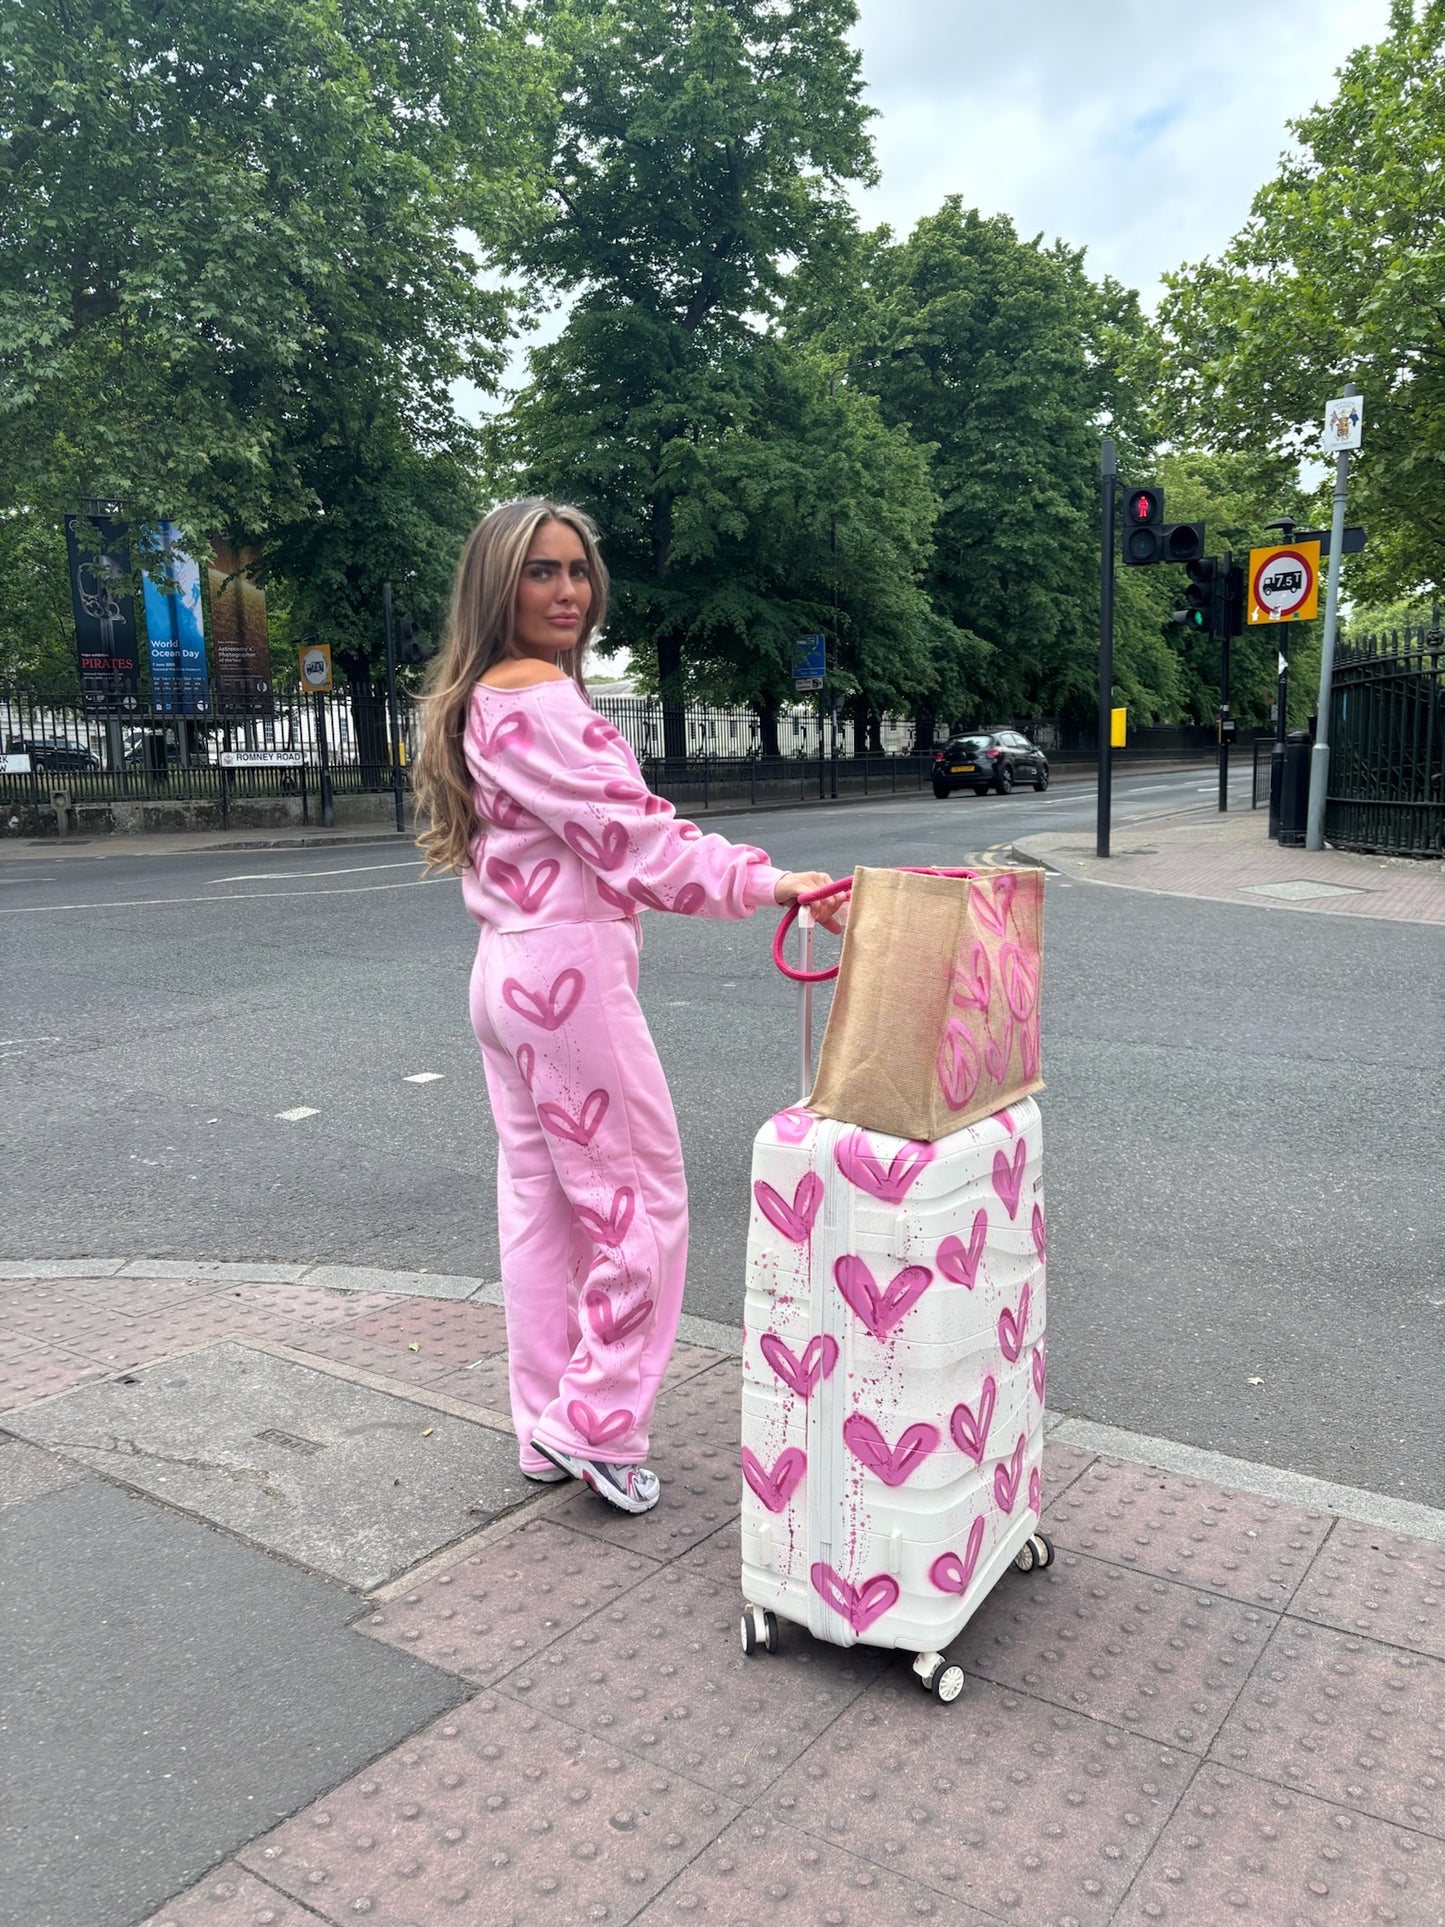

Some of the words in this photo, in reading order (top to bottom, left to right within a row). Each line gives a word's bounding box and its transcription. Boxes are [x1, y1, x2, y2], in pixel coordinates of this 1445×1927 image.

[150, 639, 178, 648] World
[151, 649, 180, 657] Ocean
[182, 649, 199, 659] Day
[81, 658, 133, 669] PIRATES
[236, 753, 274, 761] ROMNEY
[276, 753, 301, 761] ROAD
